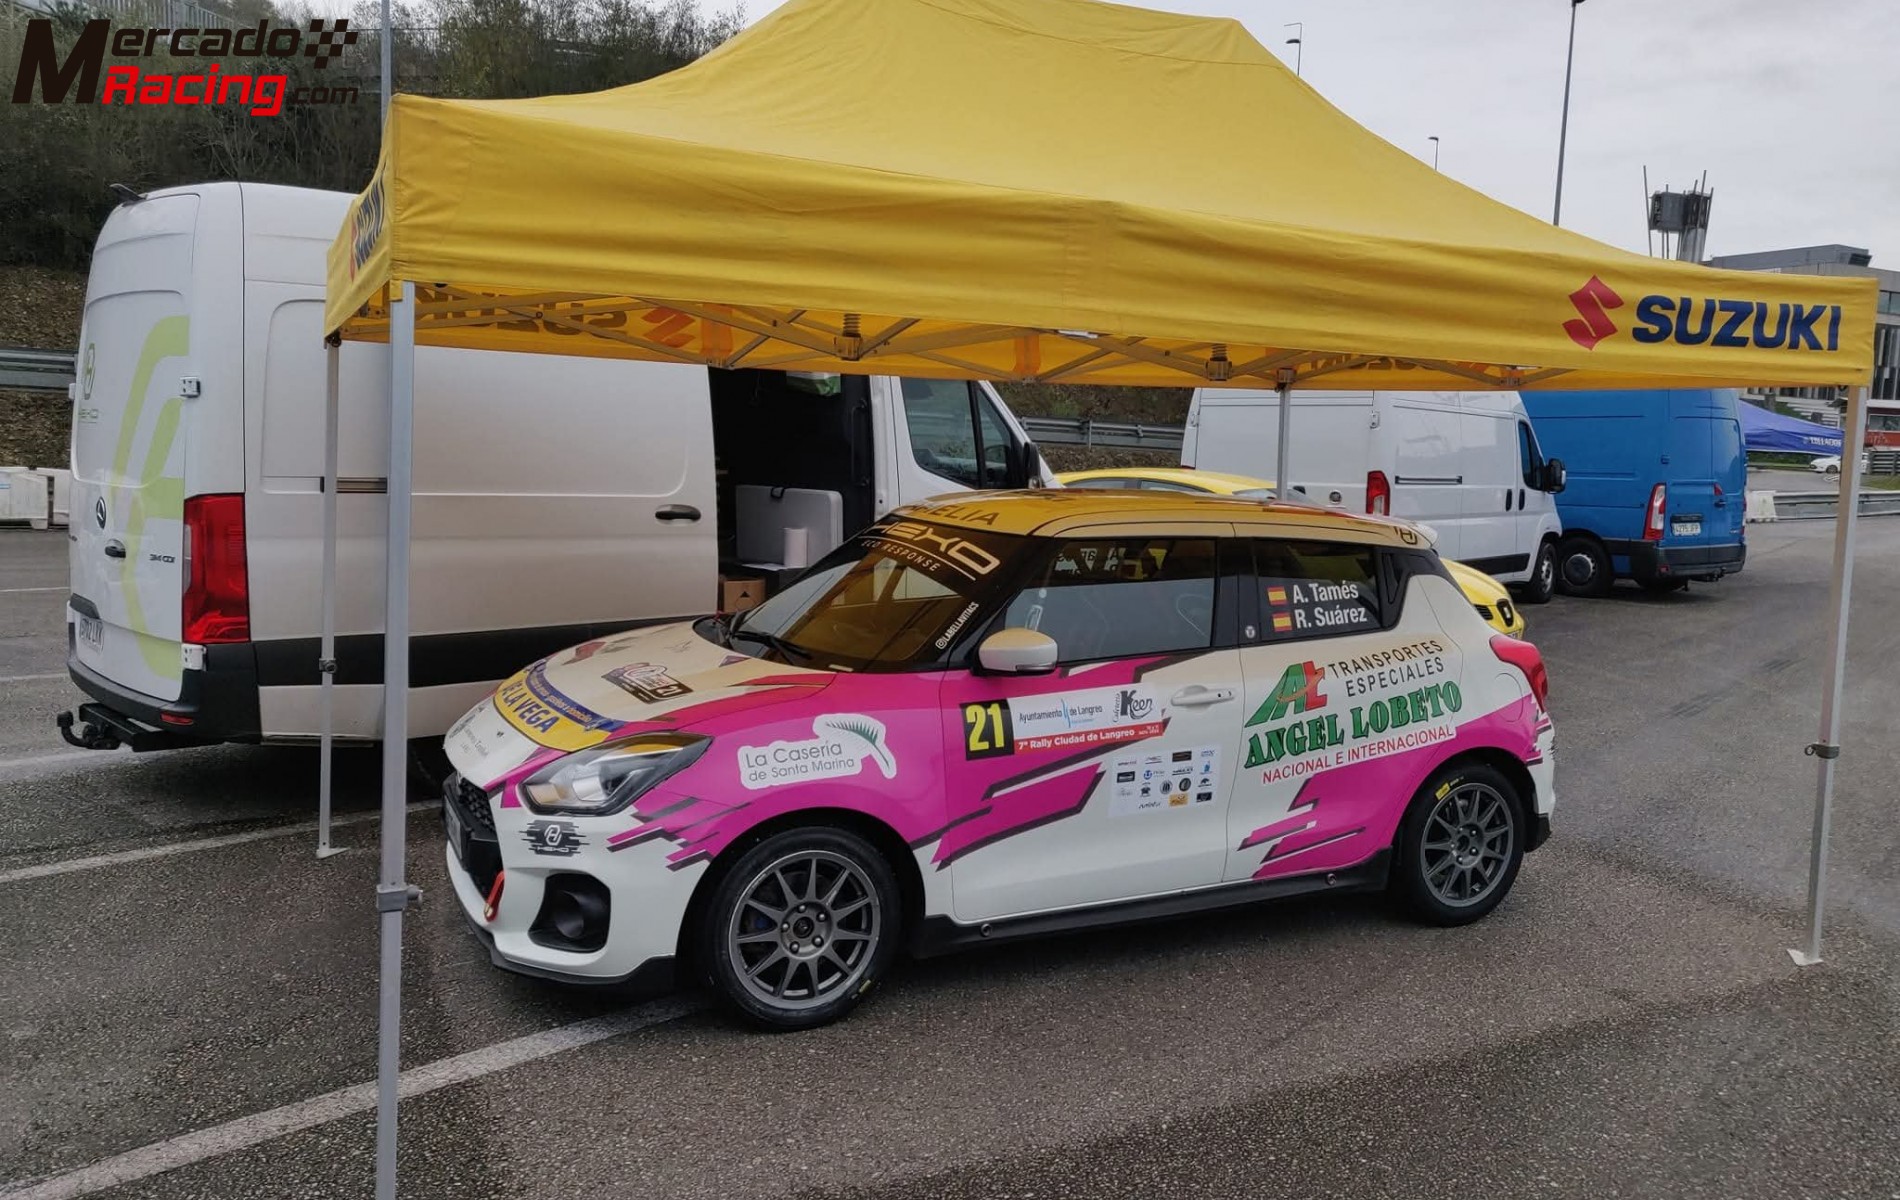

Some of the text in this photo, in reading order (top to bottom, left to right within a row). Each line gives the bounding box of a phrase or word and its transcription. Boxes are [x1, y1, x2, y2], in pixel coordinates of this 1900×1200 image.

[1631, 294, 1842, 352] SUZUKI
[881, 543, 941, 572] RESPONSE
[1293, 579, 1359, 604] A. Tamés
[1294, 604, 1368, 629] R. Suárez
[1328, 640, 1443, 679] TRANSPORTES
[1345, 656, 1445, 697] ESPECIALES
[503, 687, 528, 707] LA
[512, 697, 560, 734] VEGA
[965, 703, 1005, 753] 21
[1019, 708, 1062, 724] Ayuntamiento
[1070, 707, 1077, 716] de
[1078, 703, 1103, 717] Langreo
[1244, 680, 1463, 769] ANGEL LOBETO
[1030, 738, 1052, 749] Rally
[1054, 733, 1086, 746] Ciudad
[1087, 732, 1098, 742] de
[1100, 728, 1135, 742] Langreo
[745, 740, 842, 769] La Casería
[1262, 724, 1455, 785] NACIONAL E INTERNACIONAL
[748, 757, 855, 782] de Santa Marina
